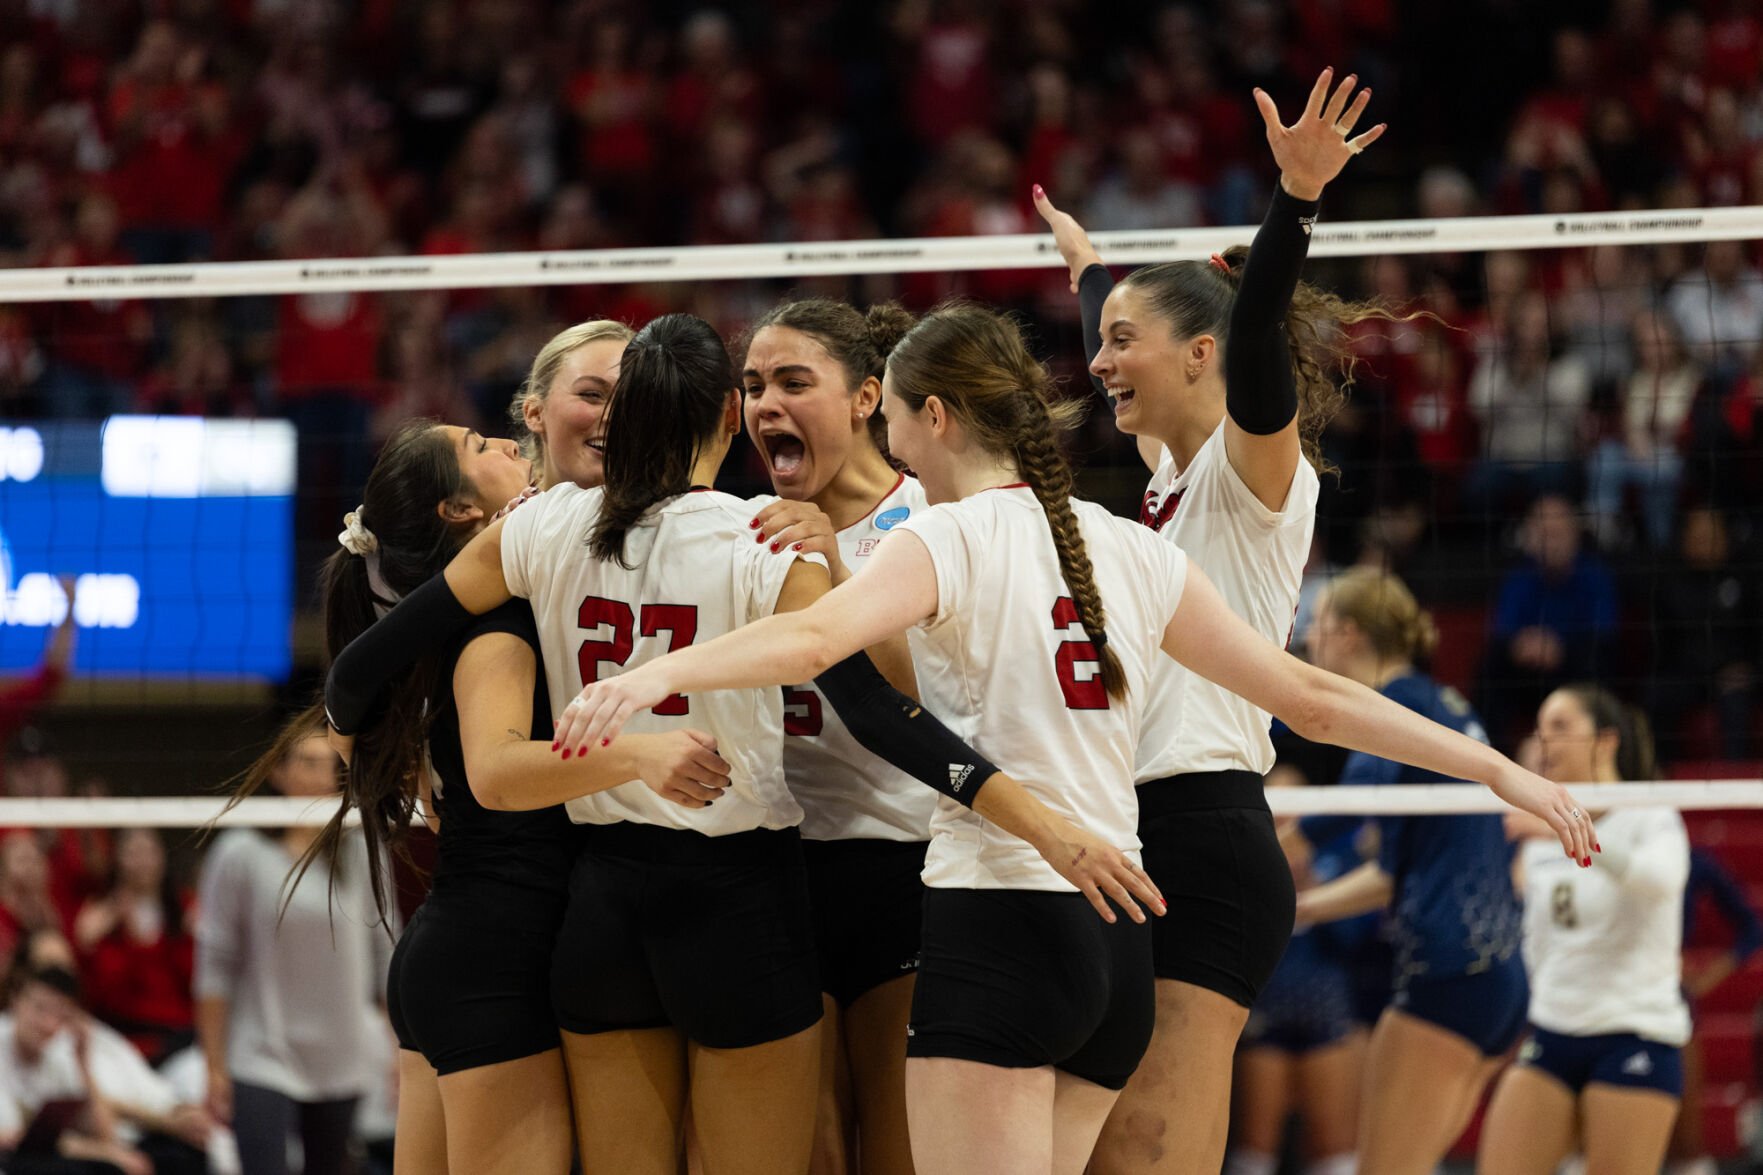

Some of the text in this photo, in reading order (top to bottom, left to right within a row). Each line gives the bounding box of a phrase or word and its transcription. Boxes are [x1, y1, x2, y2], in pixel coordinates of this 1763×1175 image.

[577, 595, 698, 716] 27
[1050, 595, 1111, 710] 2
[953, 763, 975, 792] adidas
